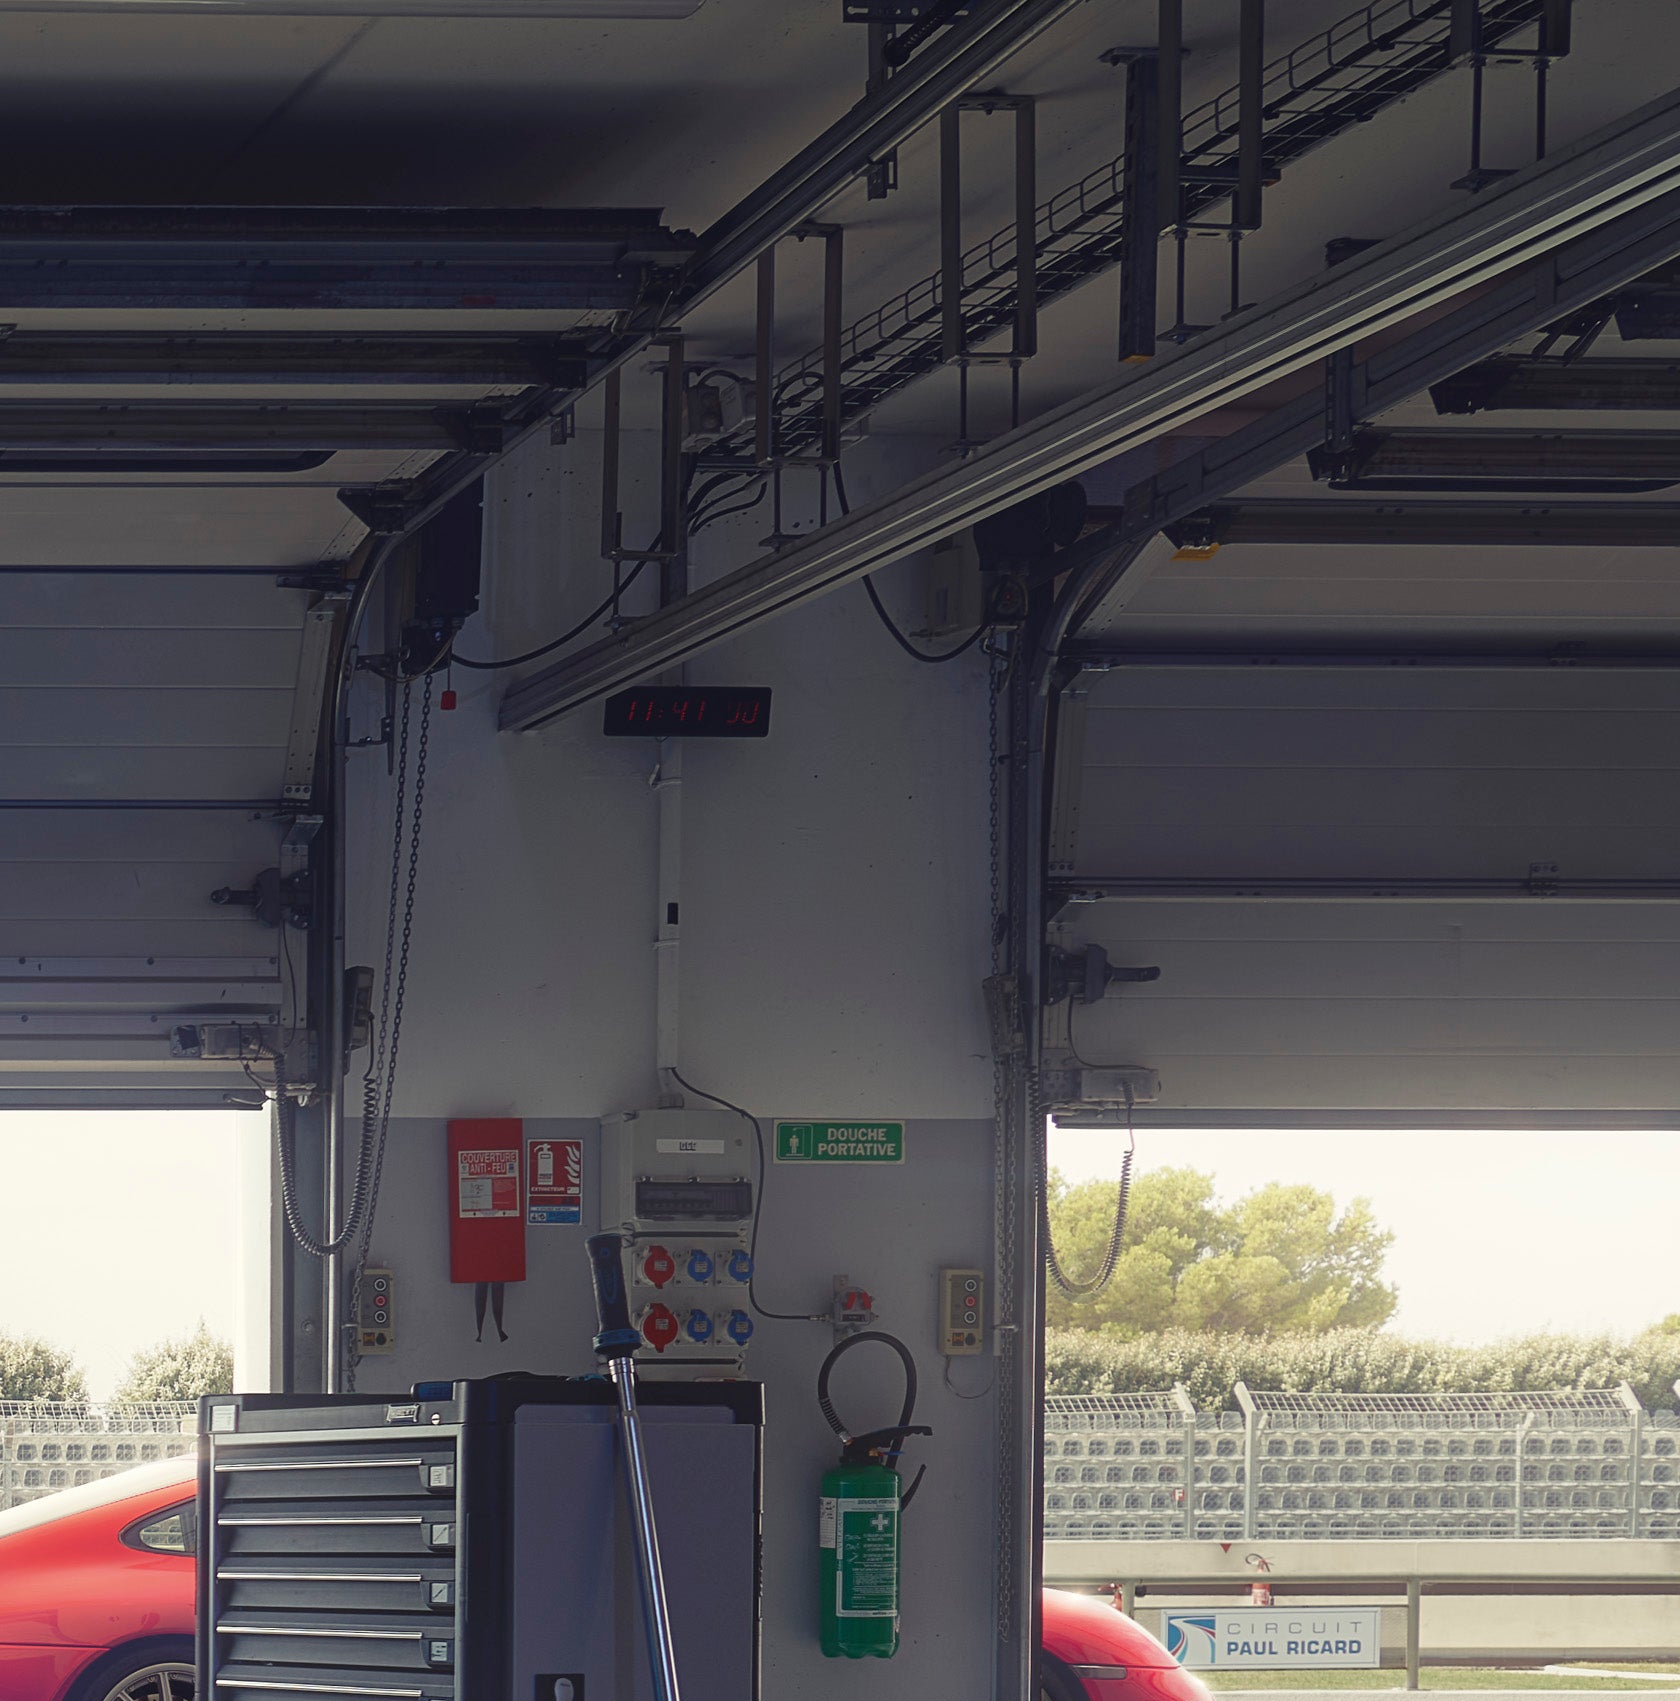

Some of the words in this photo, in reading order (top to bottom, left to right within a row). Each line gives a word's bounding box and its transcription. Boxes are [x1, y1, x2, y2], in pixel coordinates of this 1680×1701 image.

[827, 1128, 887, 1140] DOUCHE
[818, 1143, 896, 1156] PORTATIVE
[461, 1153, 517, 1163] COUVERTURE
[470, 1163, 487, 1173] ANTI
[491, 1163, 506, 1173] FEU
[1175, 1489, 1183, 1501] F
[1227, 1621, 1362, 1635] CIRCUIT
[1227, 1641, 1278, 1655] PAUL
[1286, 1640, 1362, 1655] RICARD
